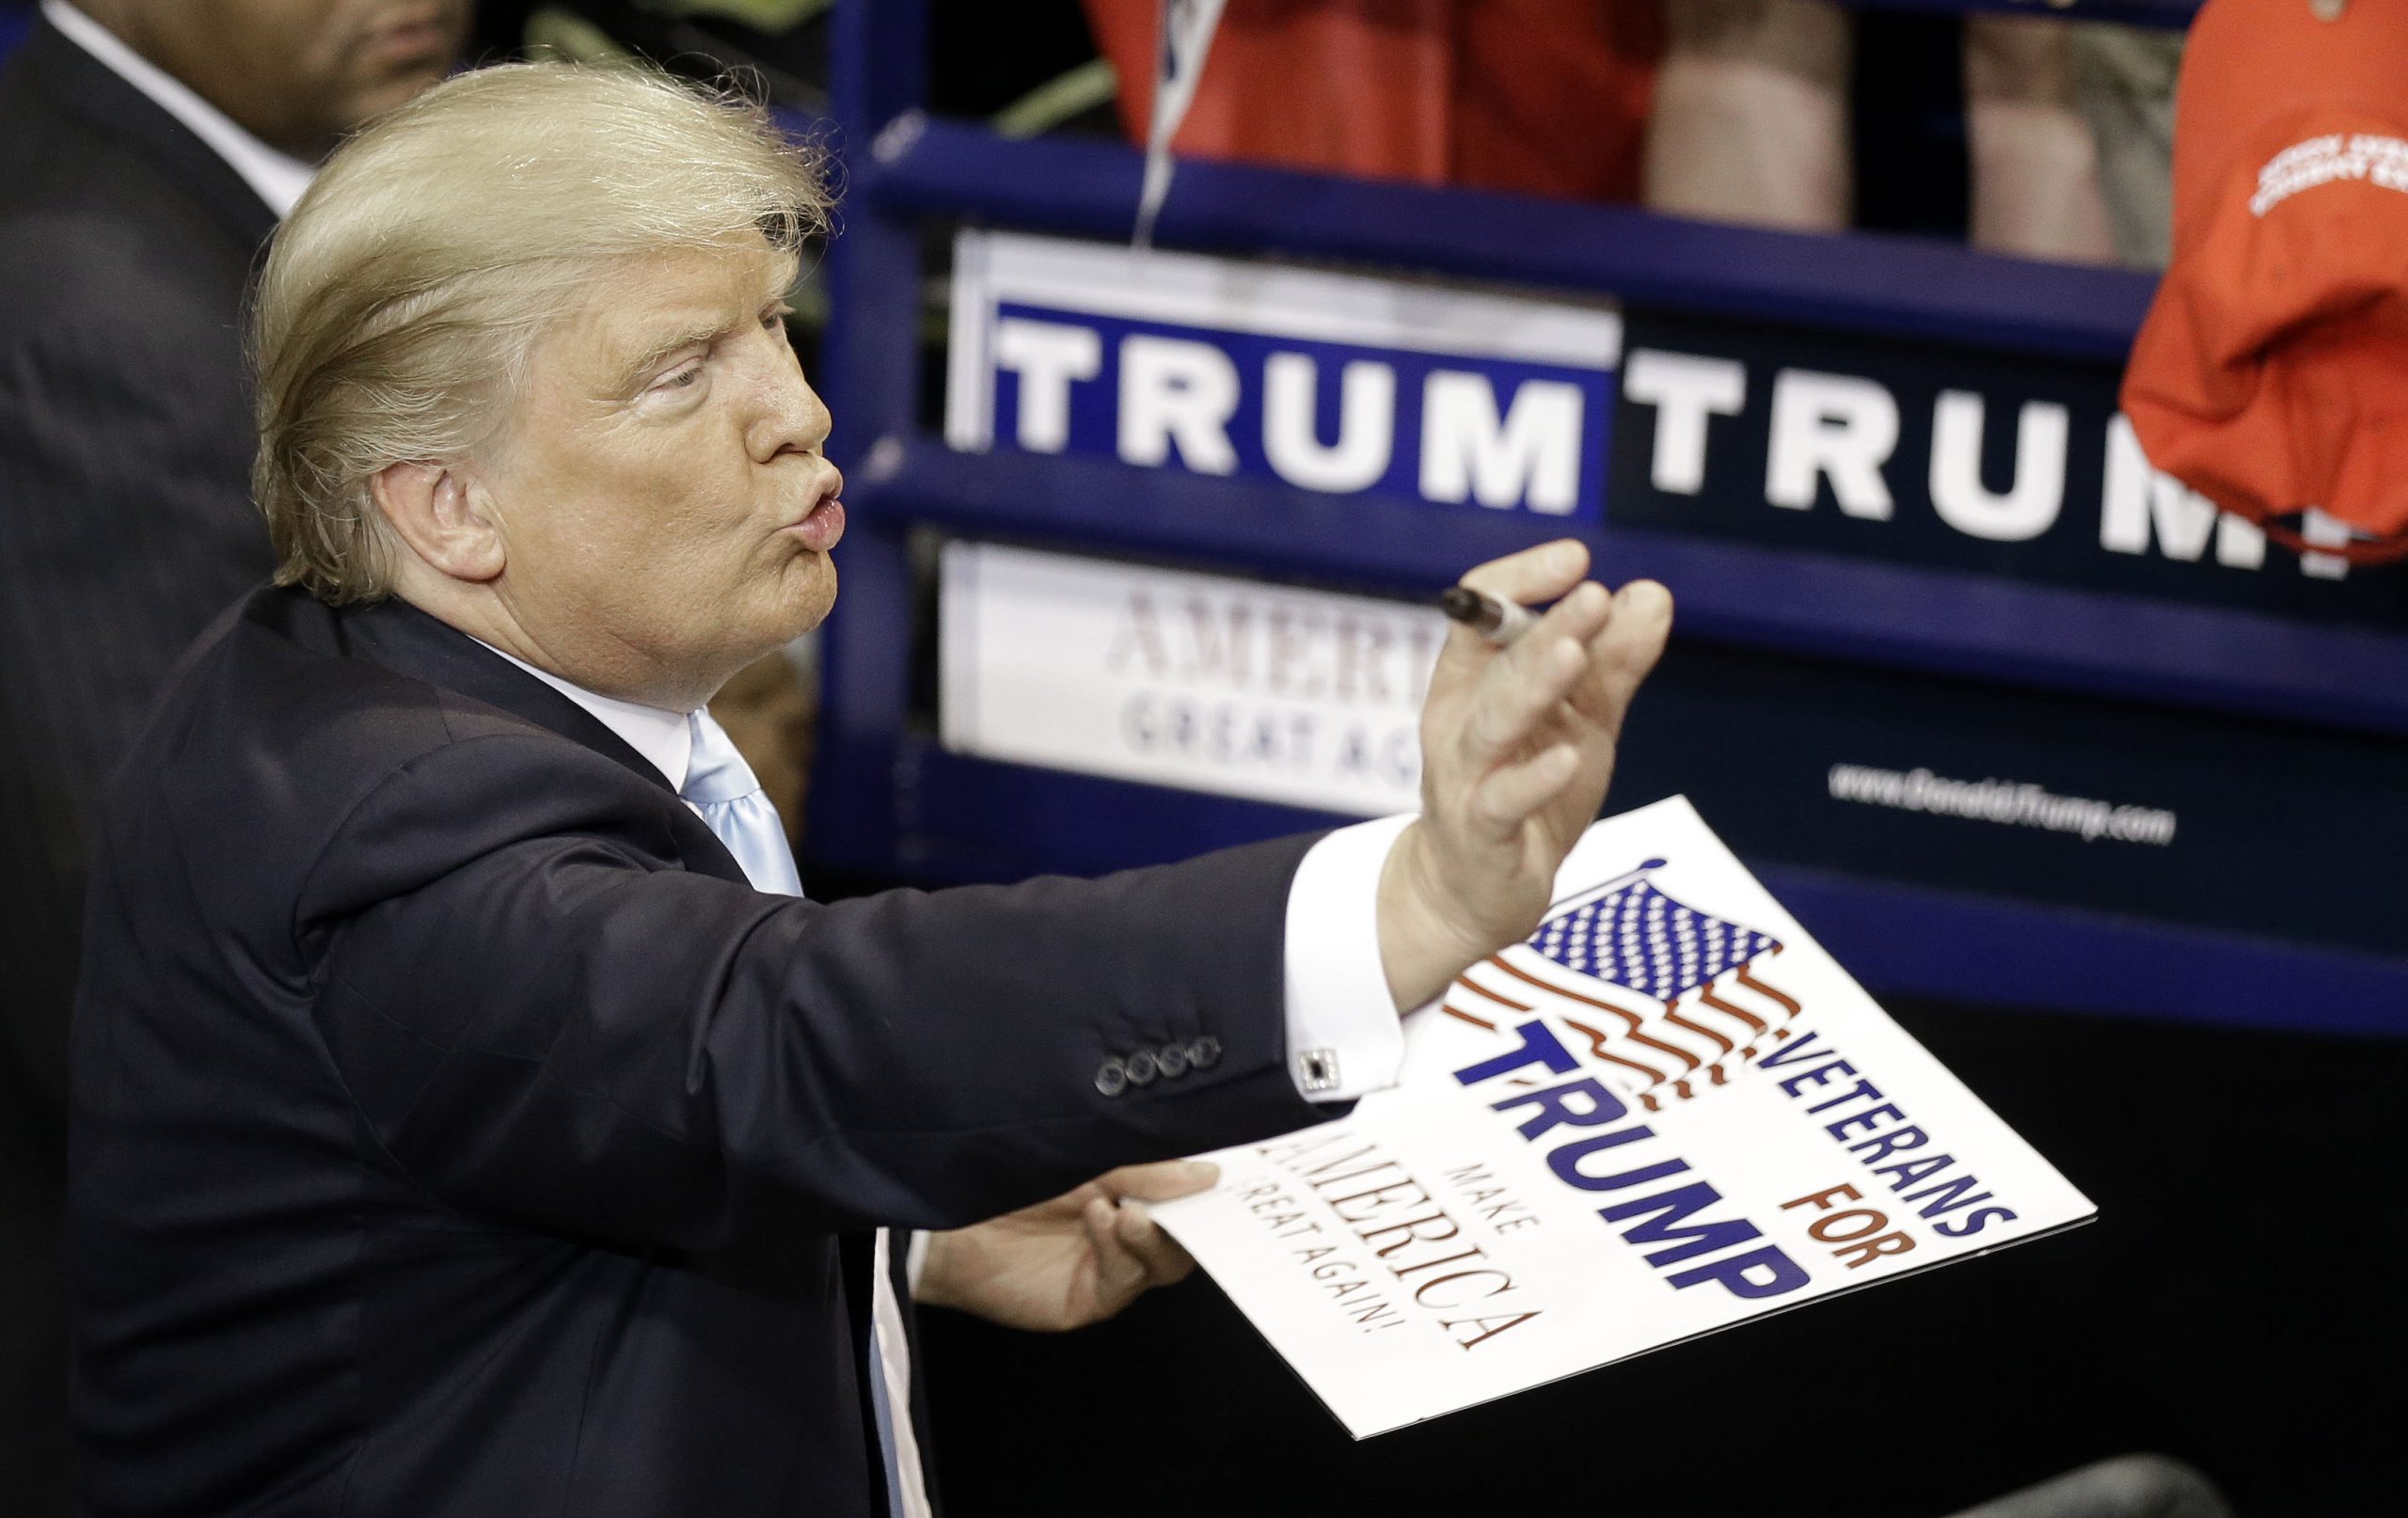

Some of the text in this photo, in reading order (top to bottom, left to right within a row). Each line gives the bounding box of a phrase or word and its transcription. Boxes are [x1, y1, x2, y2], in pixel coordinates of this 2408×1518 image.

[1444, 1162, 1541, 1235] MAKE
[1452, 1019, 1811, 1300] TRUMP
[1756, 1031, 2019, 1238] VETERANS
[1223, 1178, 1407, 1334] REAT AGAIN!
[1256, 1131, 1545, 1352] AMERICA
[1779, 1182, 1917, 1270] FOR
